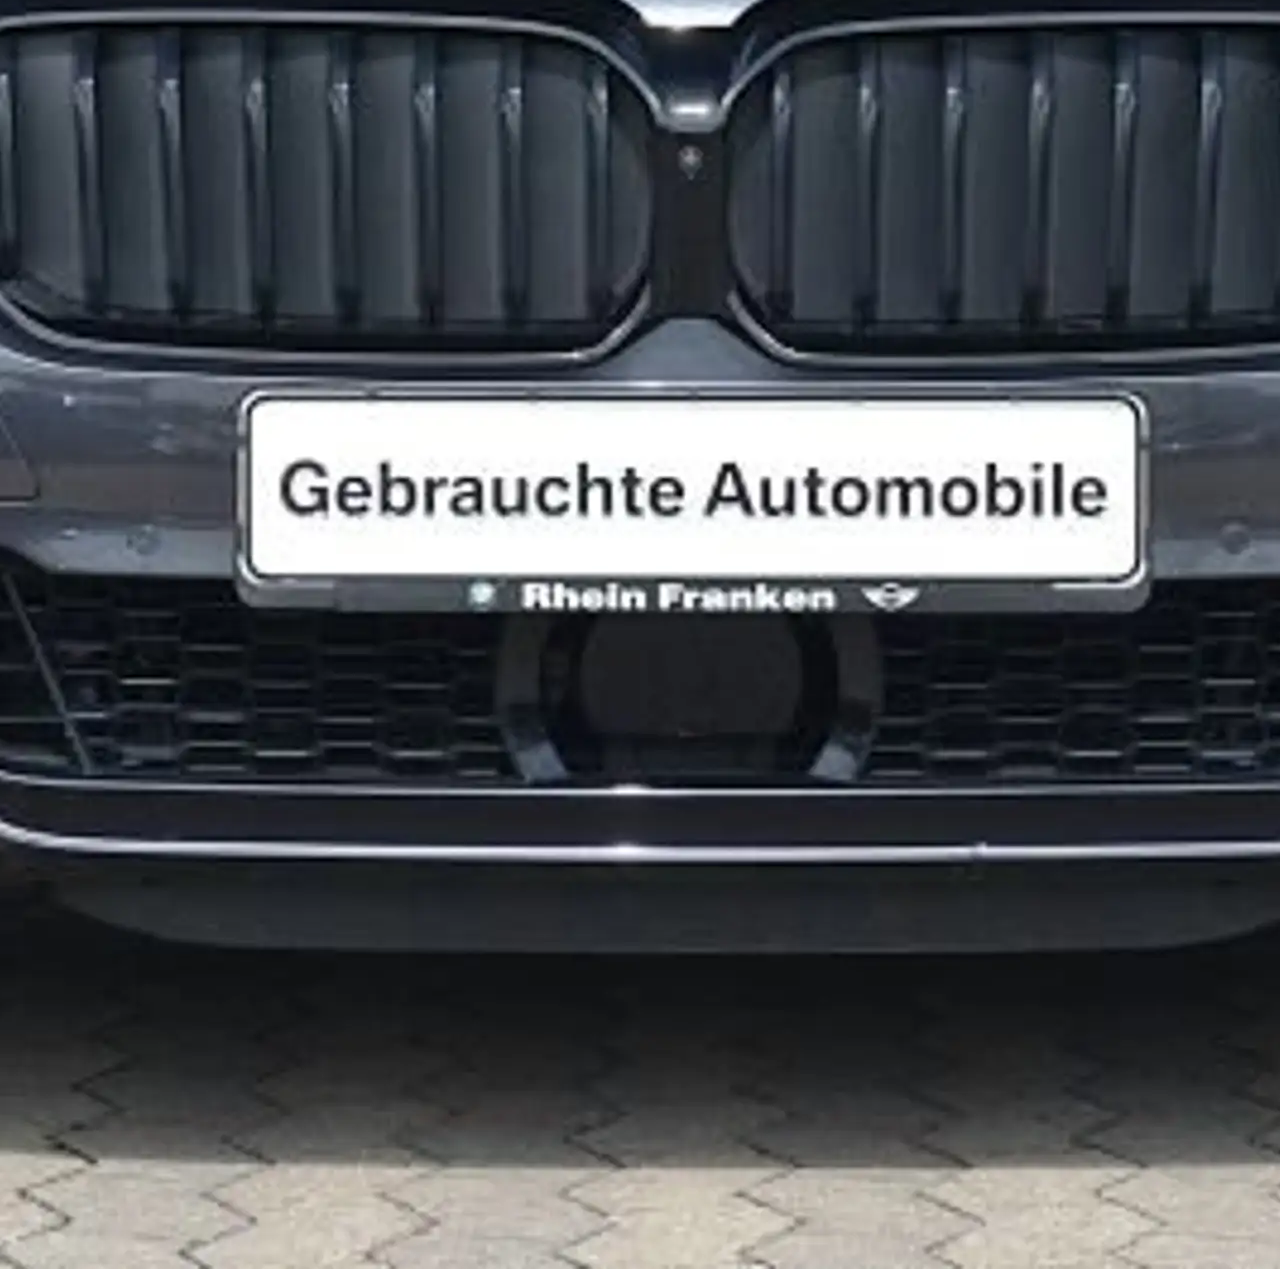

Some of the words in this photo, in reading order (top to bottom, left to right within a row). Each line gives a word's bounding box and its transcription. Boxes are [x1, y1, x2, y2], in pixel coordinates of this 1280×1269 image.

[279, 460, 686, 517] Gebrauchte
[703, 462, 1108, 517] Automobile
[520, 582, 647, 611] Rhein
[658, 582, 838, 611] Franken
